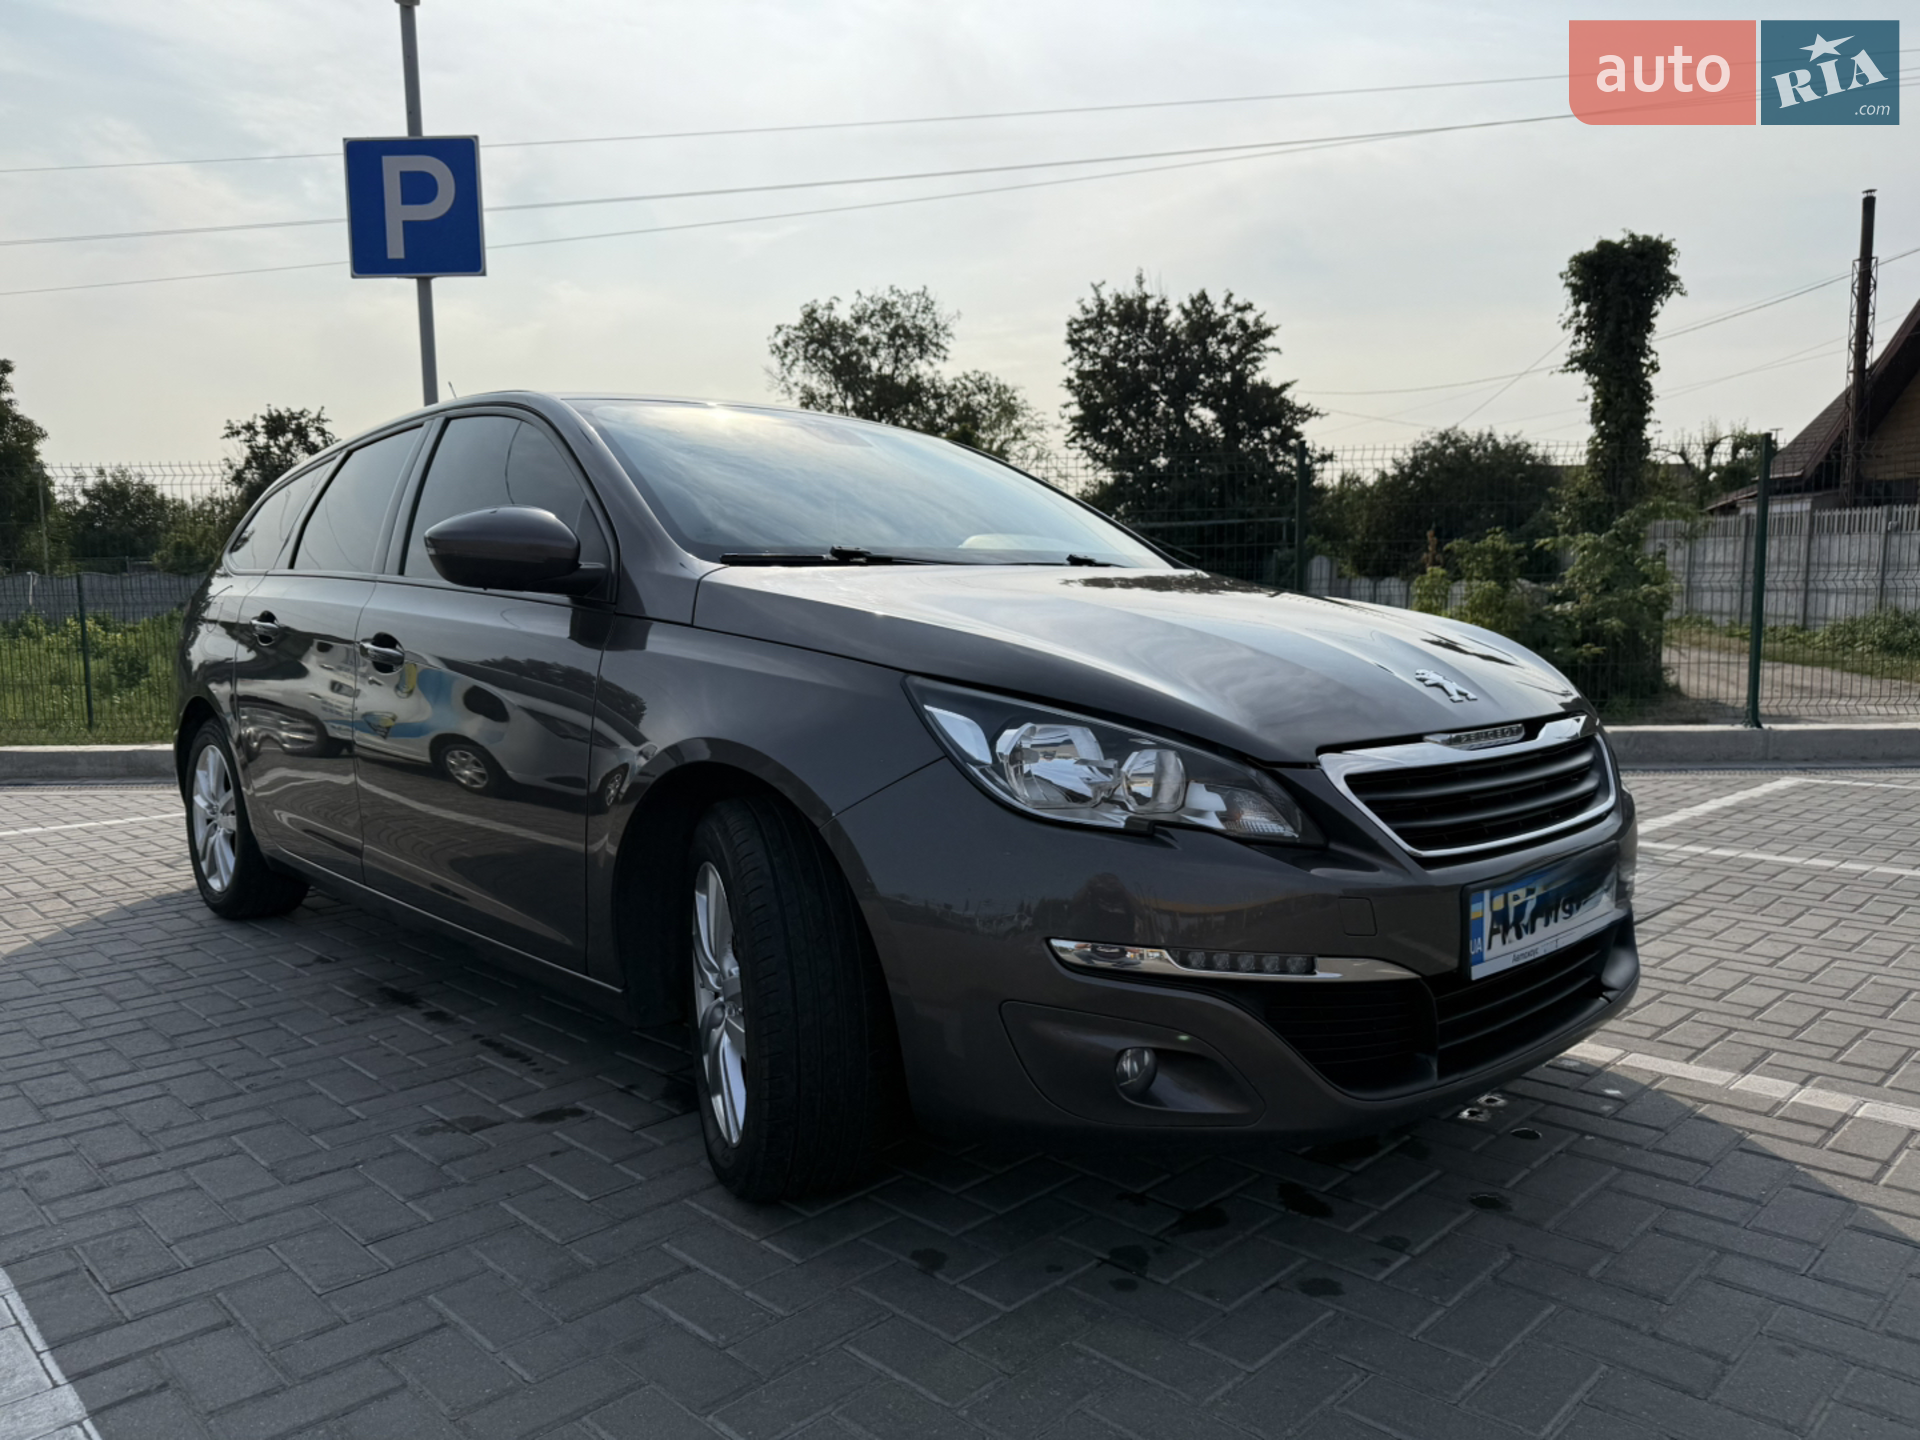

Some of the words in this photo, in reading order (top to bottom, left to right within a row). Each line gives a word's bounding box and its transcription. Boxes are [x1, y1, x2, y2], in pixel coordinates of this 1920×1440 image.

[381, 155, 456, 260] P
[1461, 727, 1518, 743] PEUGEOT
[1469, 938, 1483, 955] UA
